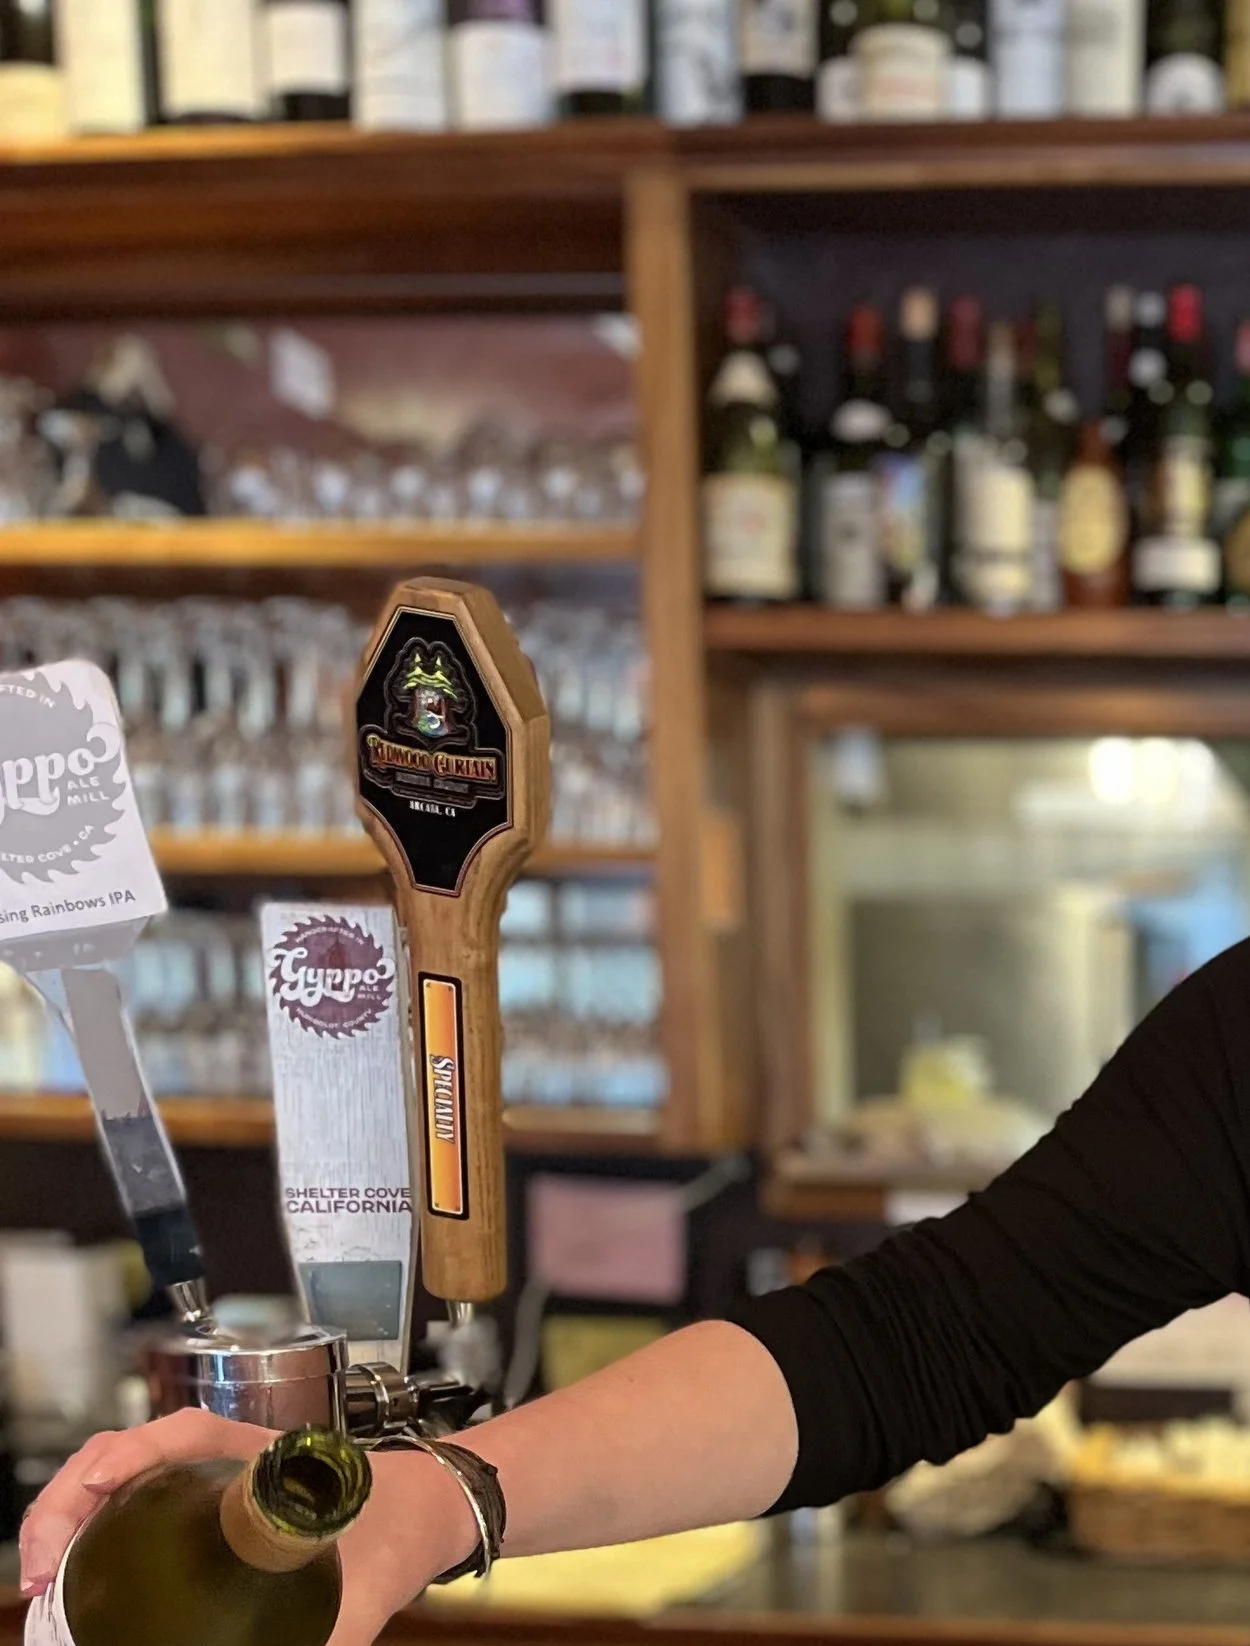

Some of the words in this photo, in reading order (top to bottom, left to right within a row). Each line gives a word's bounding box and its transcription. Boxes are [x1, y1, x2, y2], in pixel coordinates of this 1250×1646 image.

[39, 694, 57, 708] IN
[0, 722, 121, 824] ppo
[432, 752, 498, 785] CURTAIN
[67, 776, 100, 790] ALE
[67, 791, 109, 806] MILL
[0, 852, 34, 863] LTER
[38, 843, 72, 862] COVE
[31, 897, 106, 917] Rainbows
[108, 889, 136, 906] IPA
[271, 947, 396, 1007] Gyppo
[429, 1054, 456, 1144] SPECIALTY
[285, 1187, 360, 1198] SHELTER
[364, 1187, 411, 1198] COVE
[287, 1200, 413, 1214] CALIFORNIA
